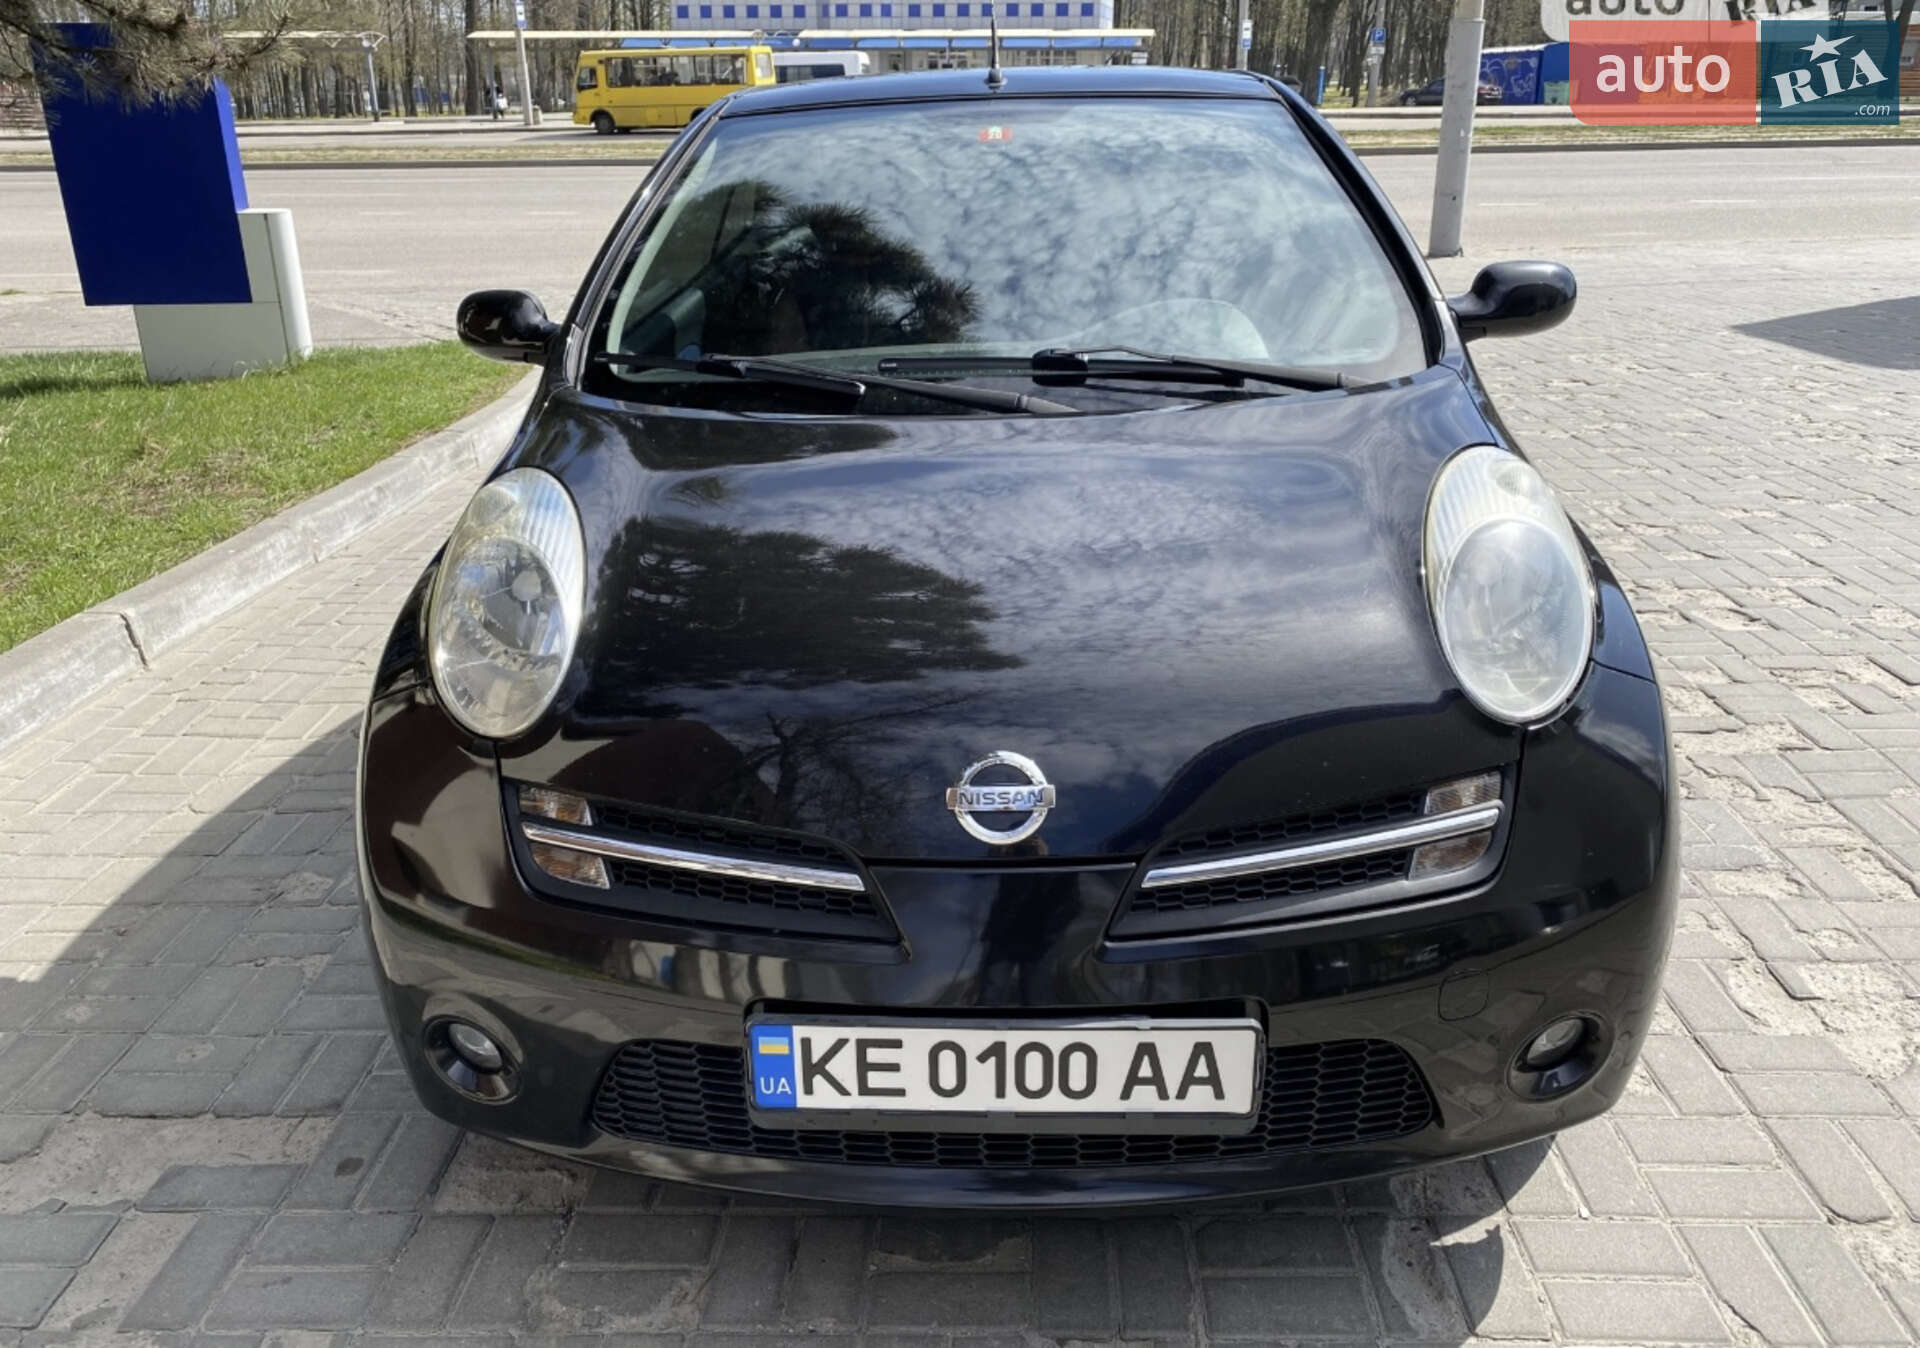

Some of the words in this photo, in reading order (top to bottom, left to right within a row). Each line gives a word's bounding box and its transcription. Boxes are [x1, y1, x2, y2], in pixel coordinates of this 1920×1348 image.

[960, 790, 1043, 806] NISSAN
[800, 1037, 906, 1097] KE
[928, 1040, 1098, 1100] 0100
[1120, 1041, 1226, 1100] AA
[760, 1077, 792, 1095] UA
